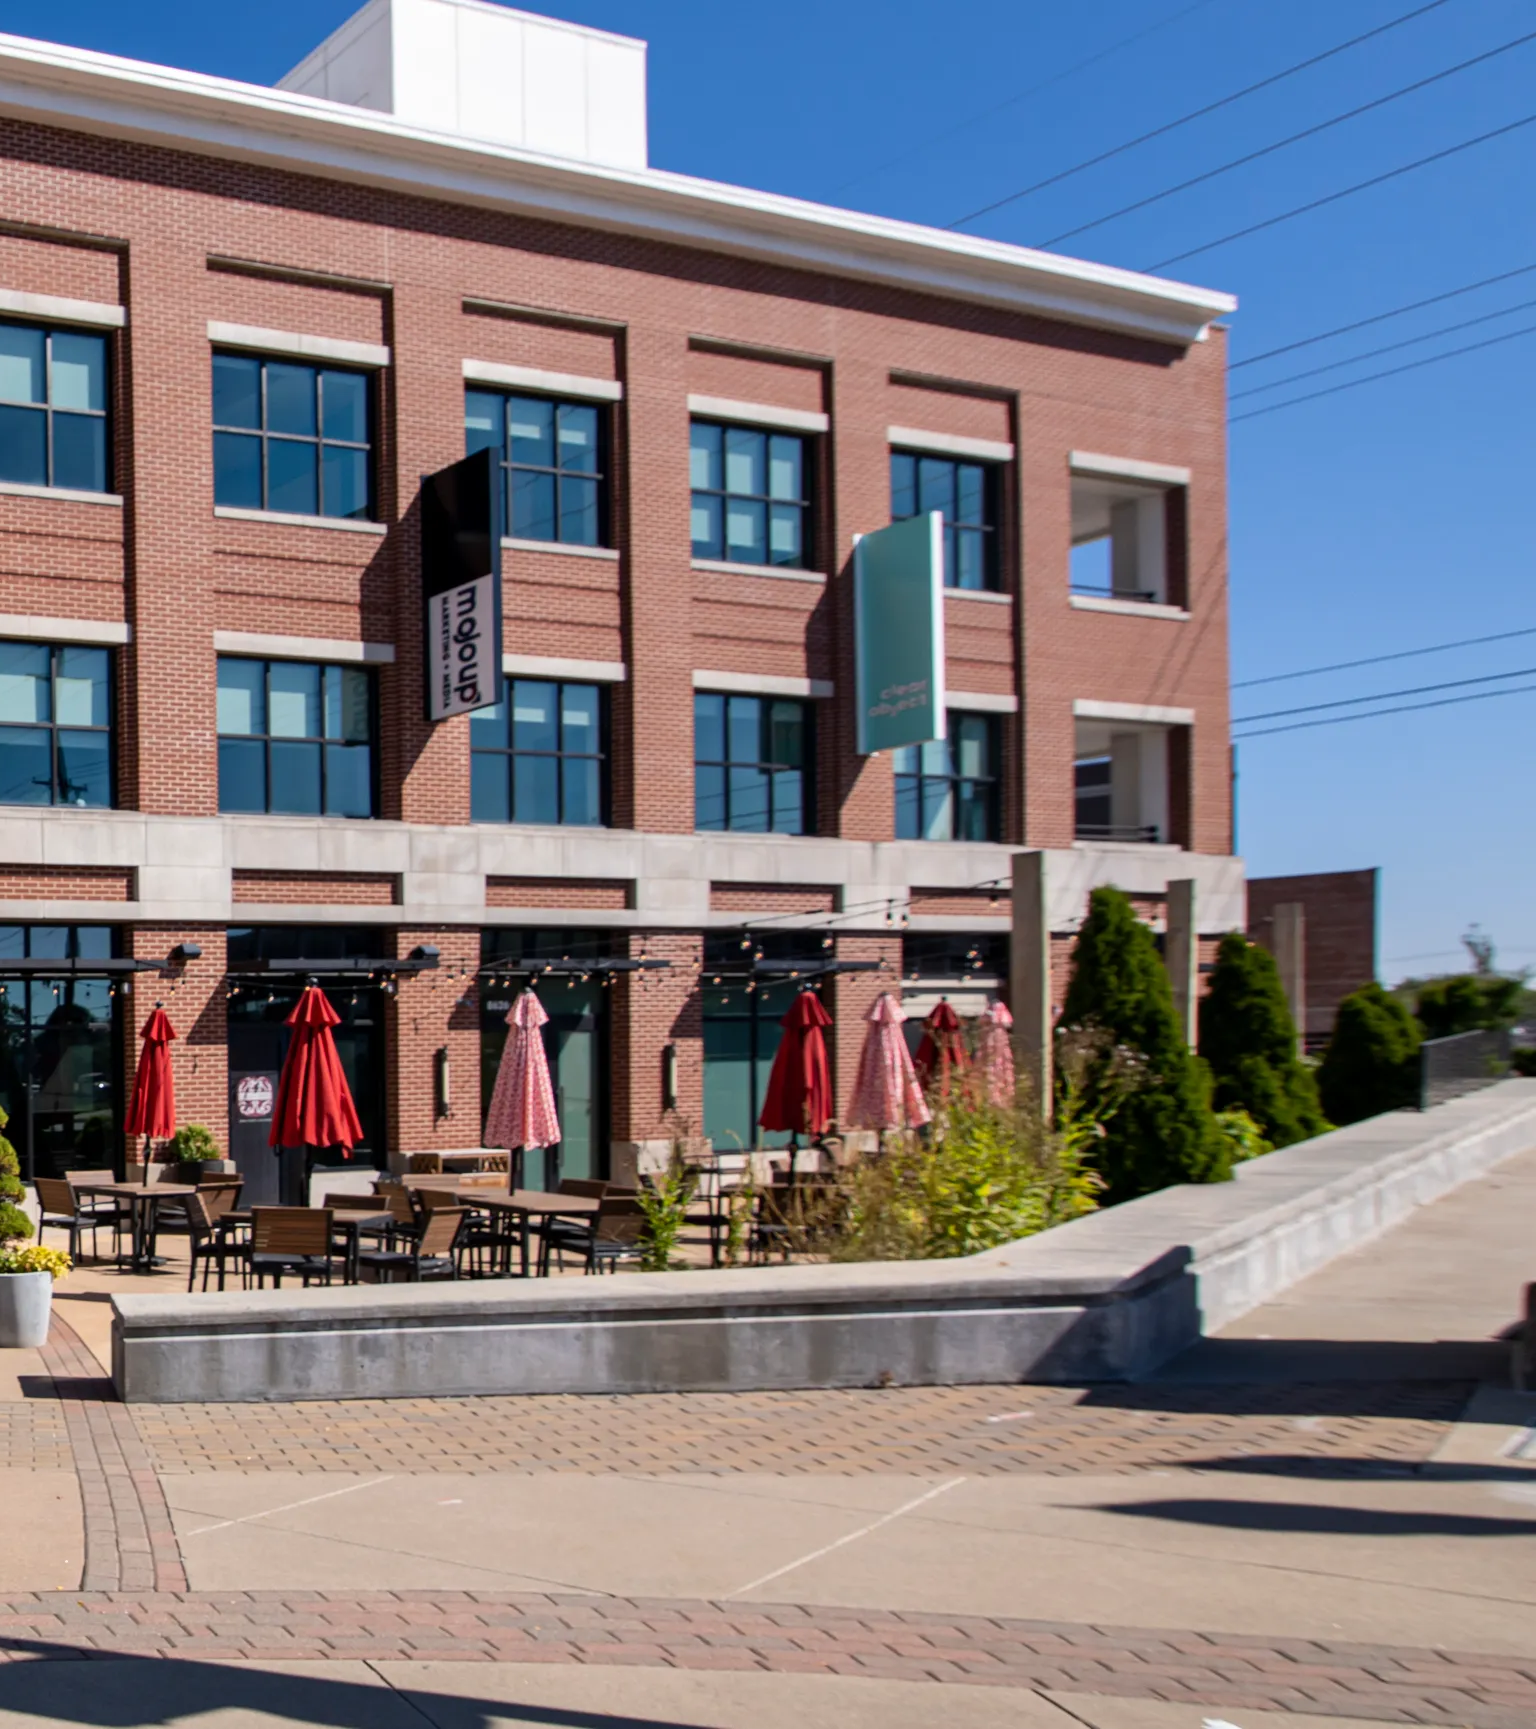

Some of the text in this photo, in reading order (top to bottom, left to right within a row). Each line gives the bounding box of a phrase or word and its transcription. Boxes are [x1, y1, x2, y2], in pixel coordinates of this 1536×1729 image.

[442, 596, 451, 660] MARKETING
[453, 585, 481, 704] mojoup
[443, 673, 451, 709] MEDIA
